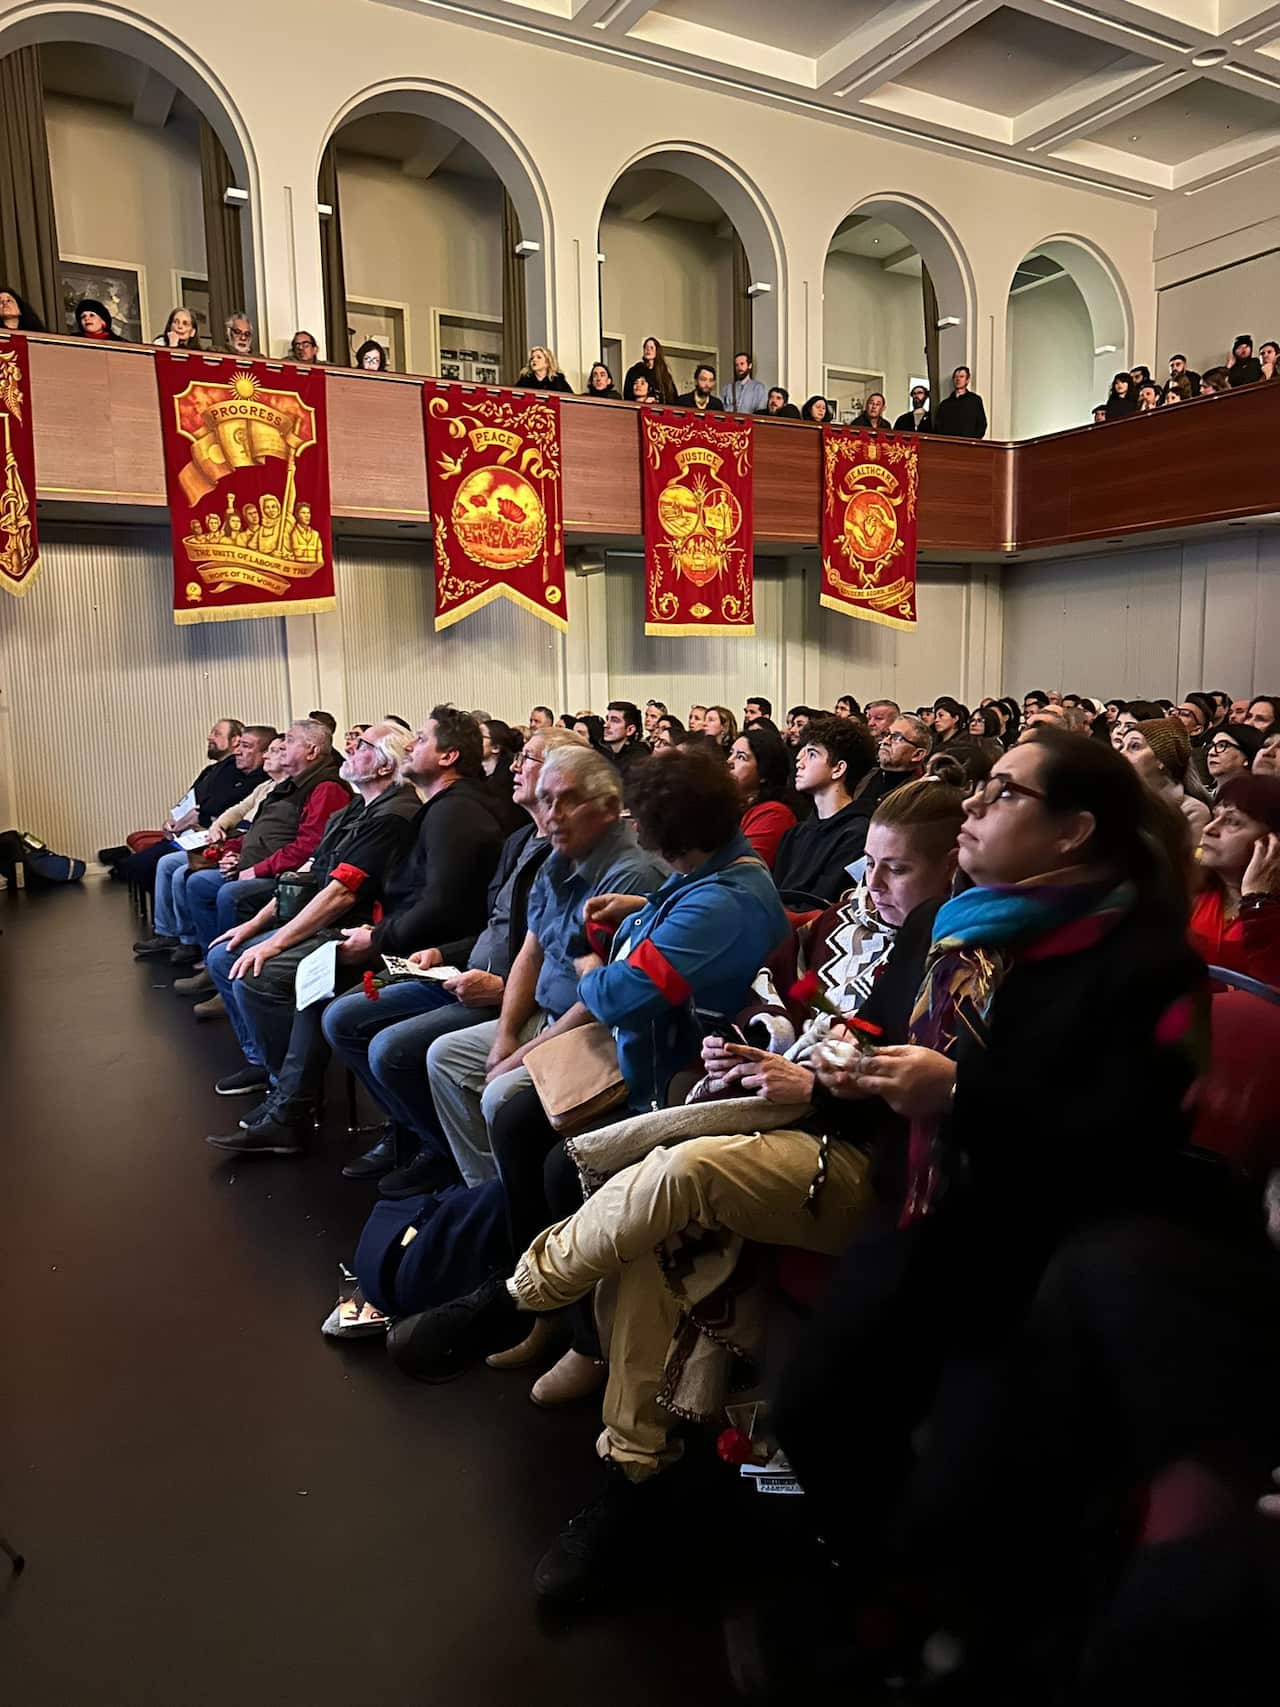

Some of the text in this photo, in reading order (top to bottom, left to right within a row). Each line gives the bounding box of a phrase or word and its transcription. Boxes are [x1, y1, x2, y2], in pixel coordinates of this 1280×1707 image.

[210, 405, 282, 426] PROGRESS
[475, 431, 514, 446] PEACE
[680, 451, 719, 466] JUSTICE
[846, 466, 897, 488] HEALTHCARE
[195, 549, 210, 557] THE
[212, 549, 235, 559] UNITY
[237, 552, 249, 560] OF
[249, 555, 281, 570] LABOUR
[293, 567, 308, 576] THE
[208, 571, 229, 580] HOPE
[242, 572, 256, 581] THE
[256, 576, 281, 591] WORLD
